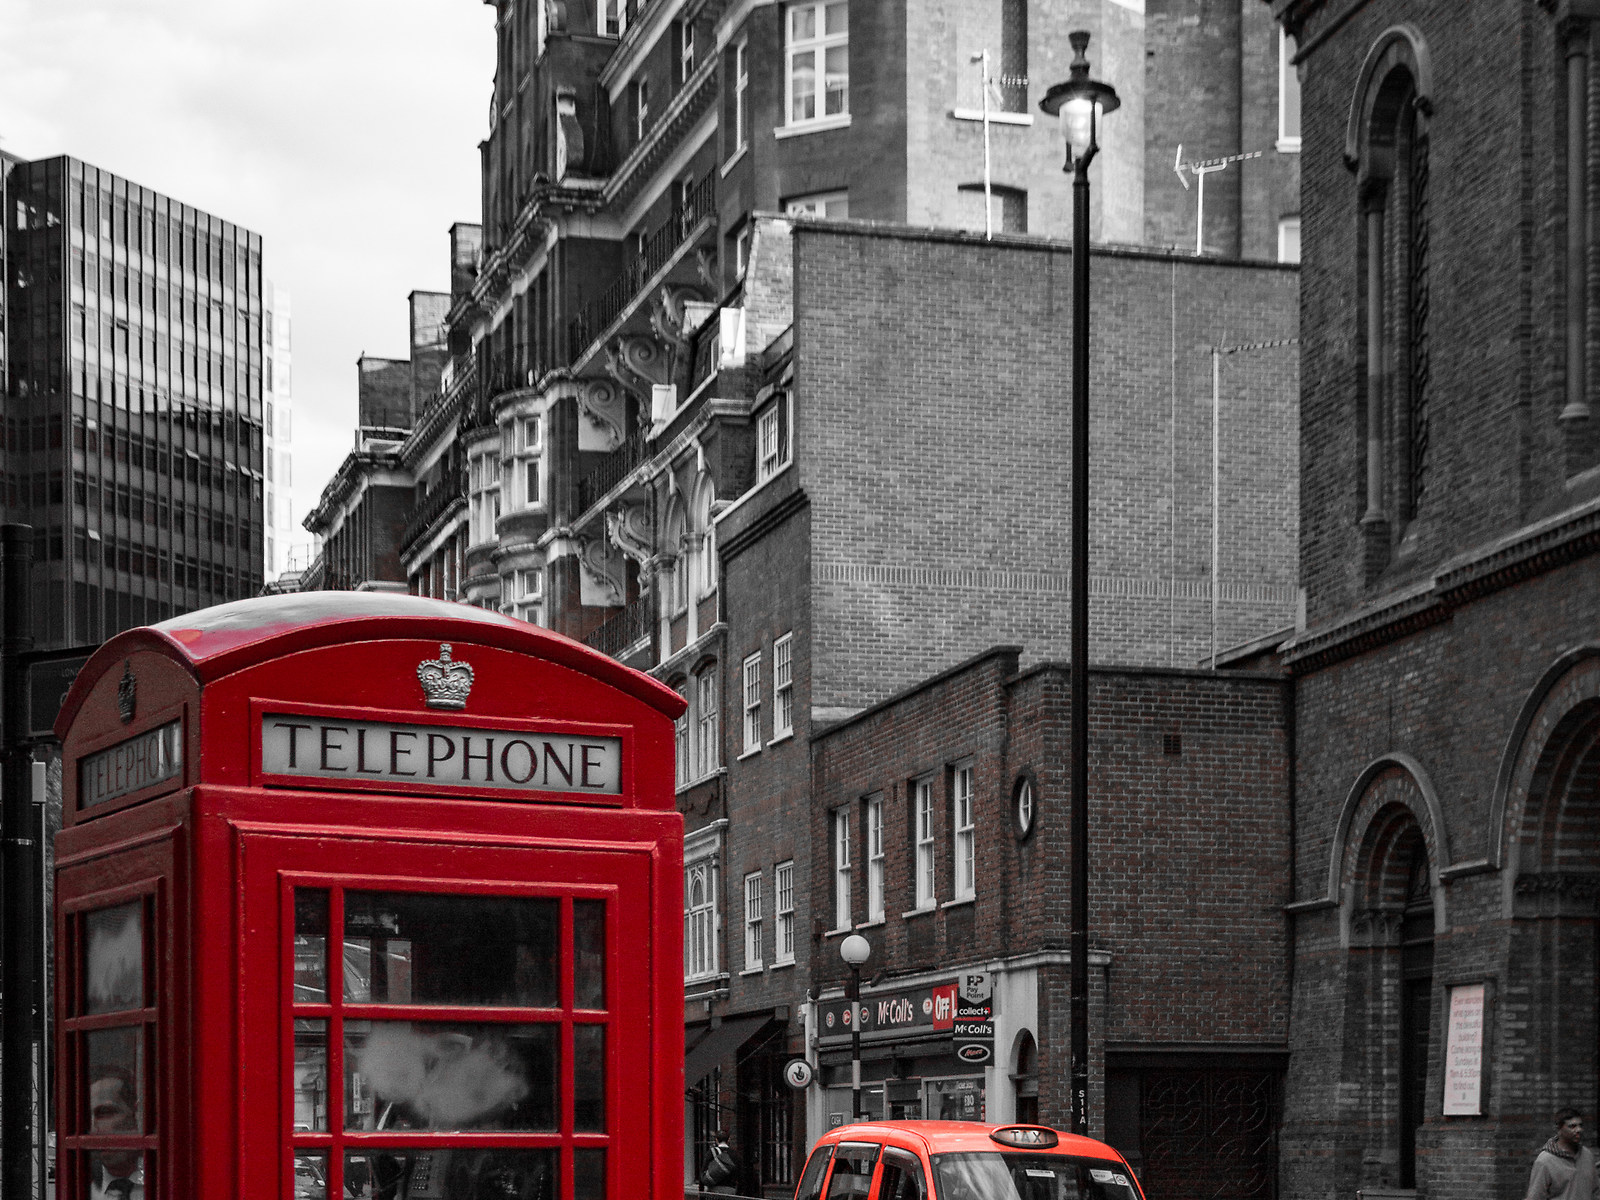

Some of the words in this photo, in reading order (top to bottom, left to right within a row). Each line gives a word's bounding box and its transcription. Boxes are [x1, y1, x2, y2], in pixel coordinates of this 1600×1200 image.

[273, 722, 606, 789] TELEPHONE
[877, 998, 914, 1025] McColl's
[954, 1024, 993, 1034] McColl's
[1010, 1130, 1048, 1144] TAXI
